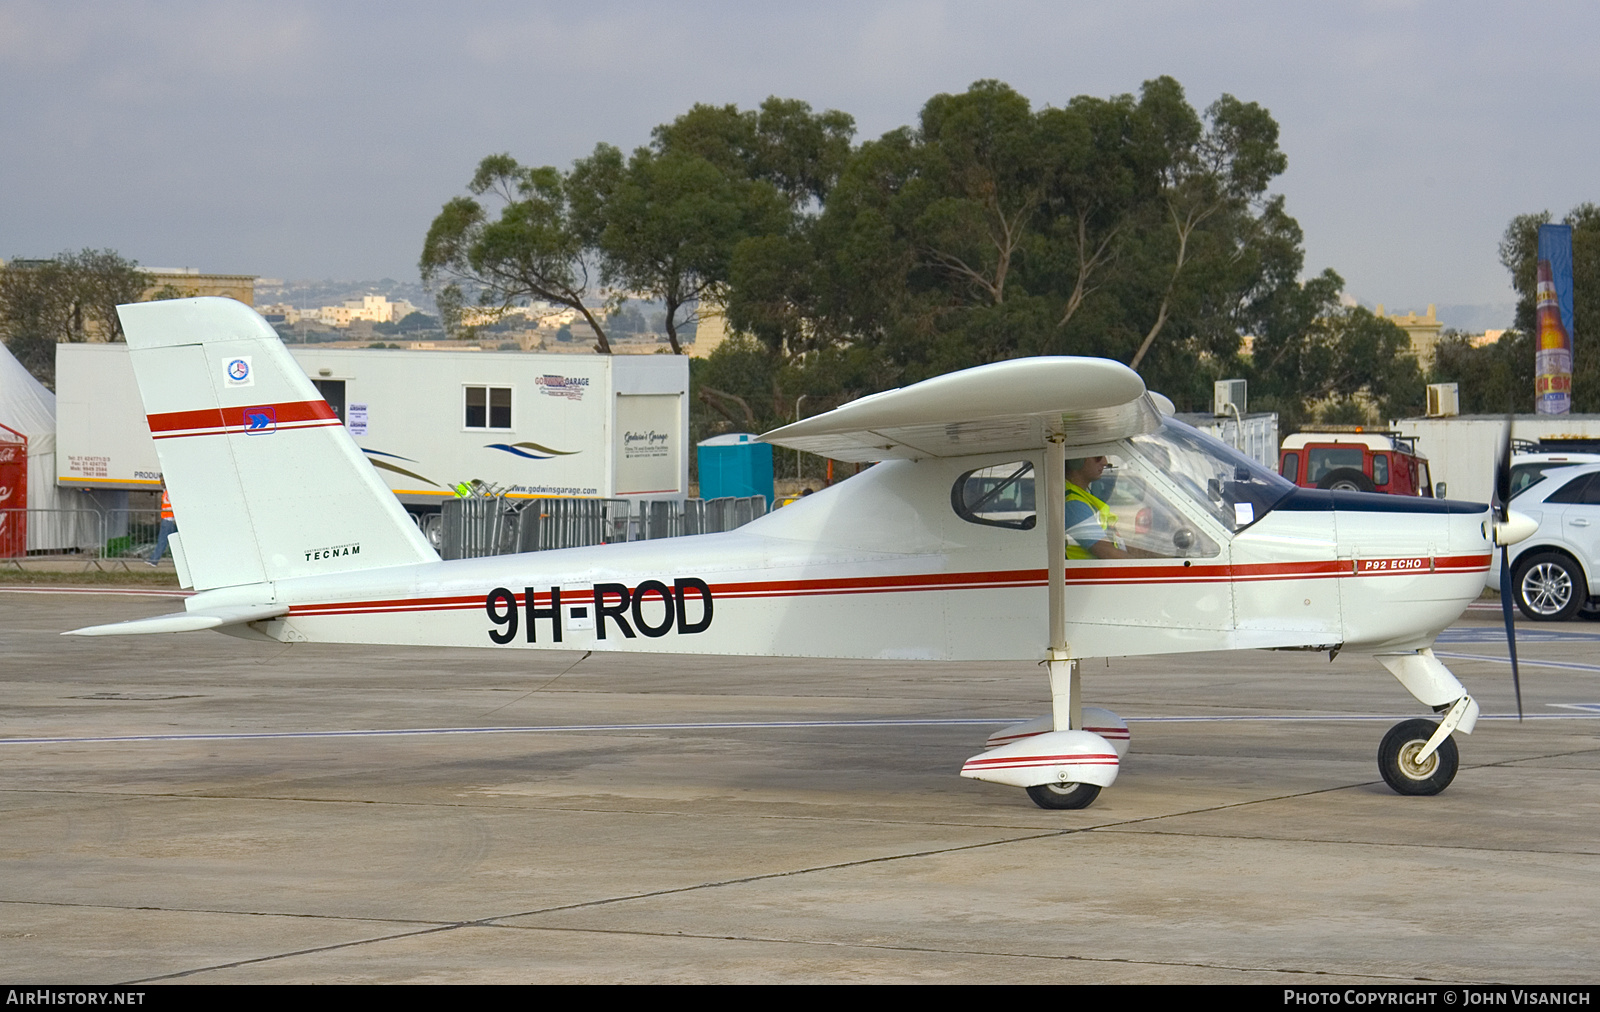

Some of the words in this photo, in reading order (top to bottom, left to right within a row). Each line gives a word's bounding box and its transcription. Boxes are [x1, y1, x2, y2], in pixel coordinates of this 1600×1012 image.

[1537, 376, 1571, 393] CISK
[624, 431, 648, 446] Godwin's
[648, 430, 668, 445] Garage
[134, 471, 162, 480] PRODU
[305, 545, 360, 561] TECNAM
[1365, 561, 1387, 570] P92
[1391, 559, 1422, 569] ECHO
[486, 577, 713, 645] 9H-ROD
